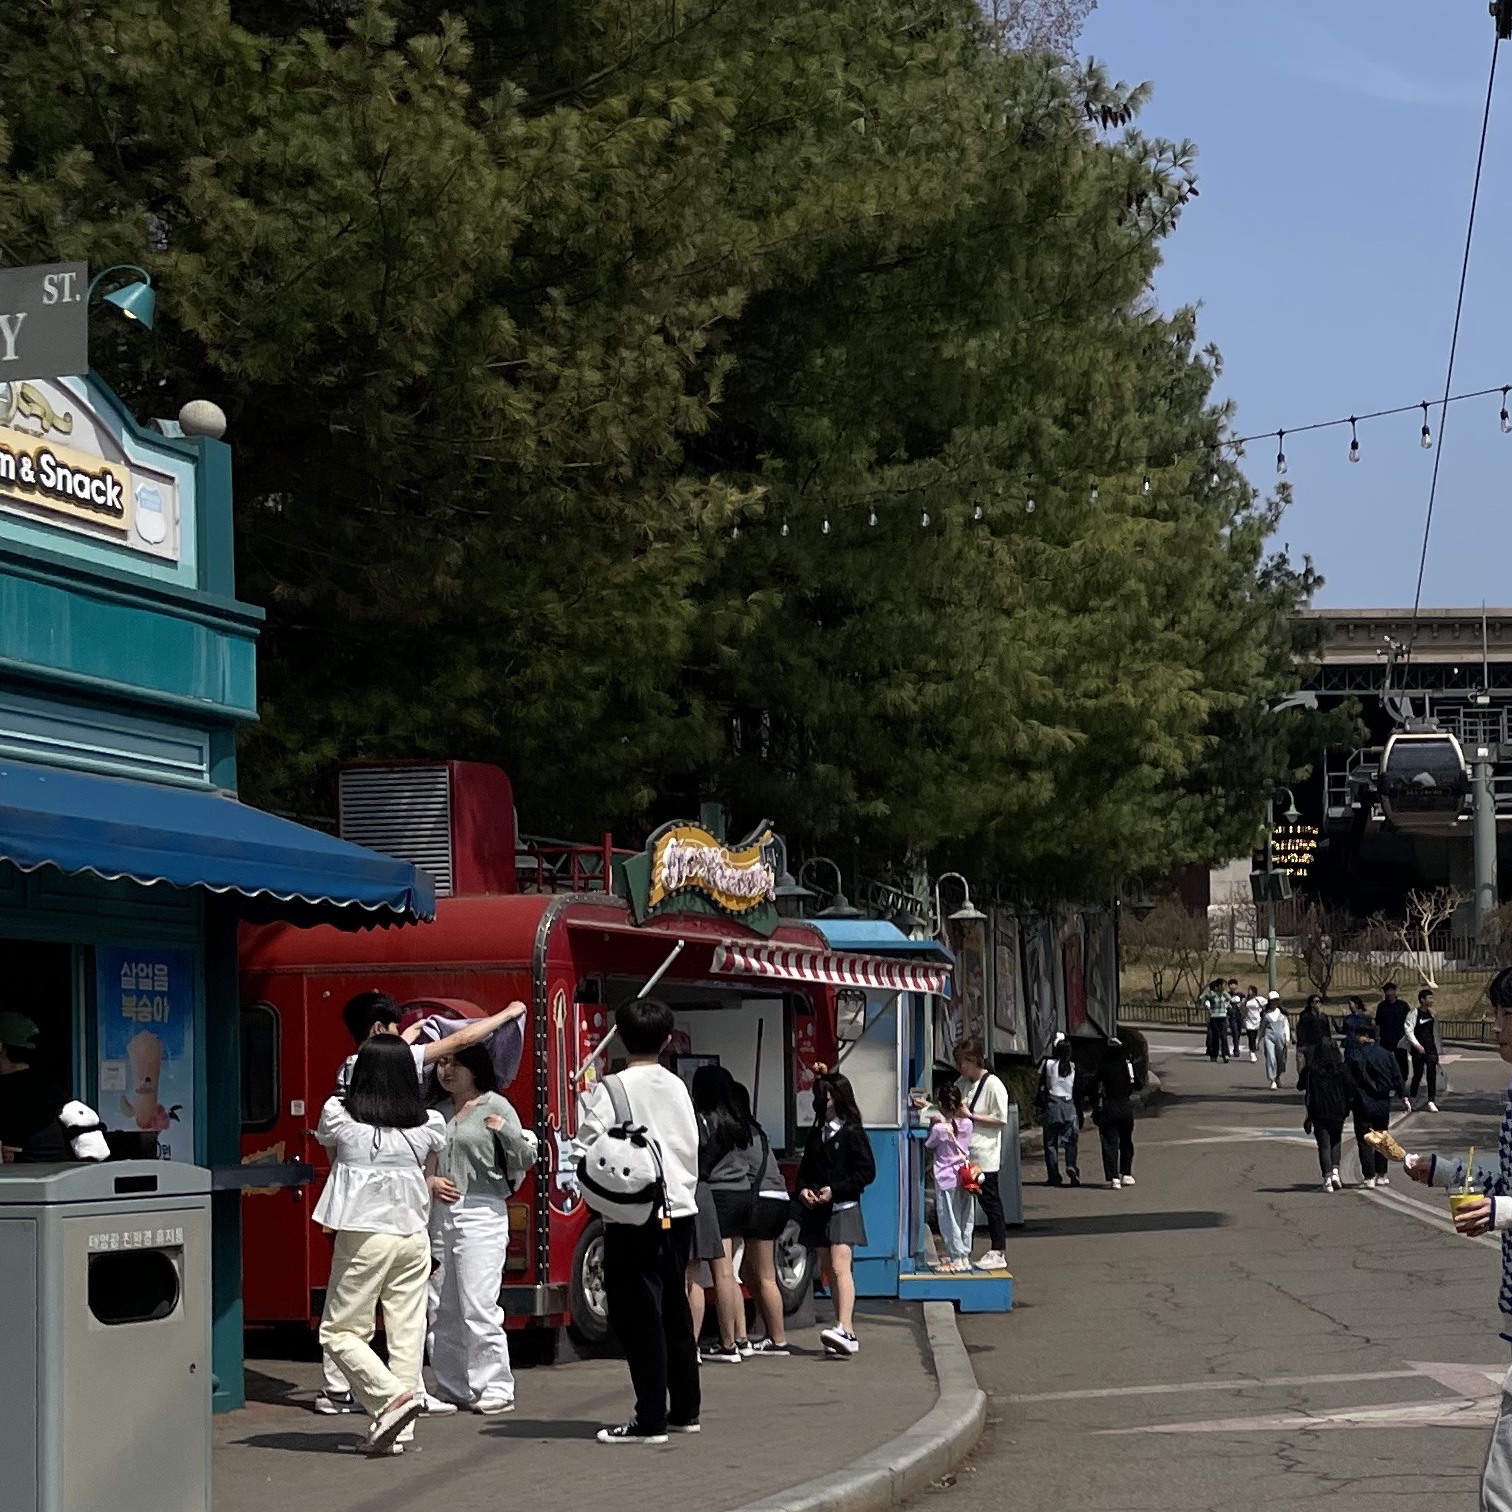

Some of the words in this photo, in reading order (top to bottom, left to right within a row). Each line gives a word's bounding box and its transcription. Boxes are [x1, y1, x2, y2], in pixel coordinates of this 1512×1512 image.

[42, 271, 81, 305] ST.
[20, 456, 36, 484] &
[39, 452, 122, 510] Snack
[121, 993, 170, 1023] 복숭아
